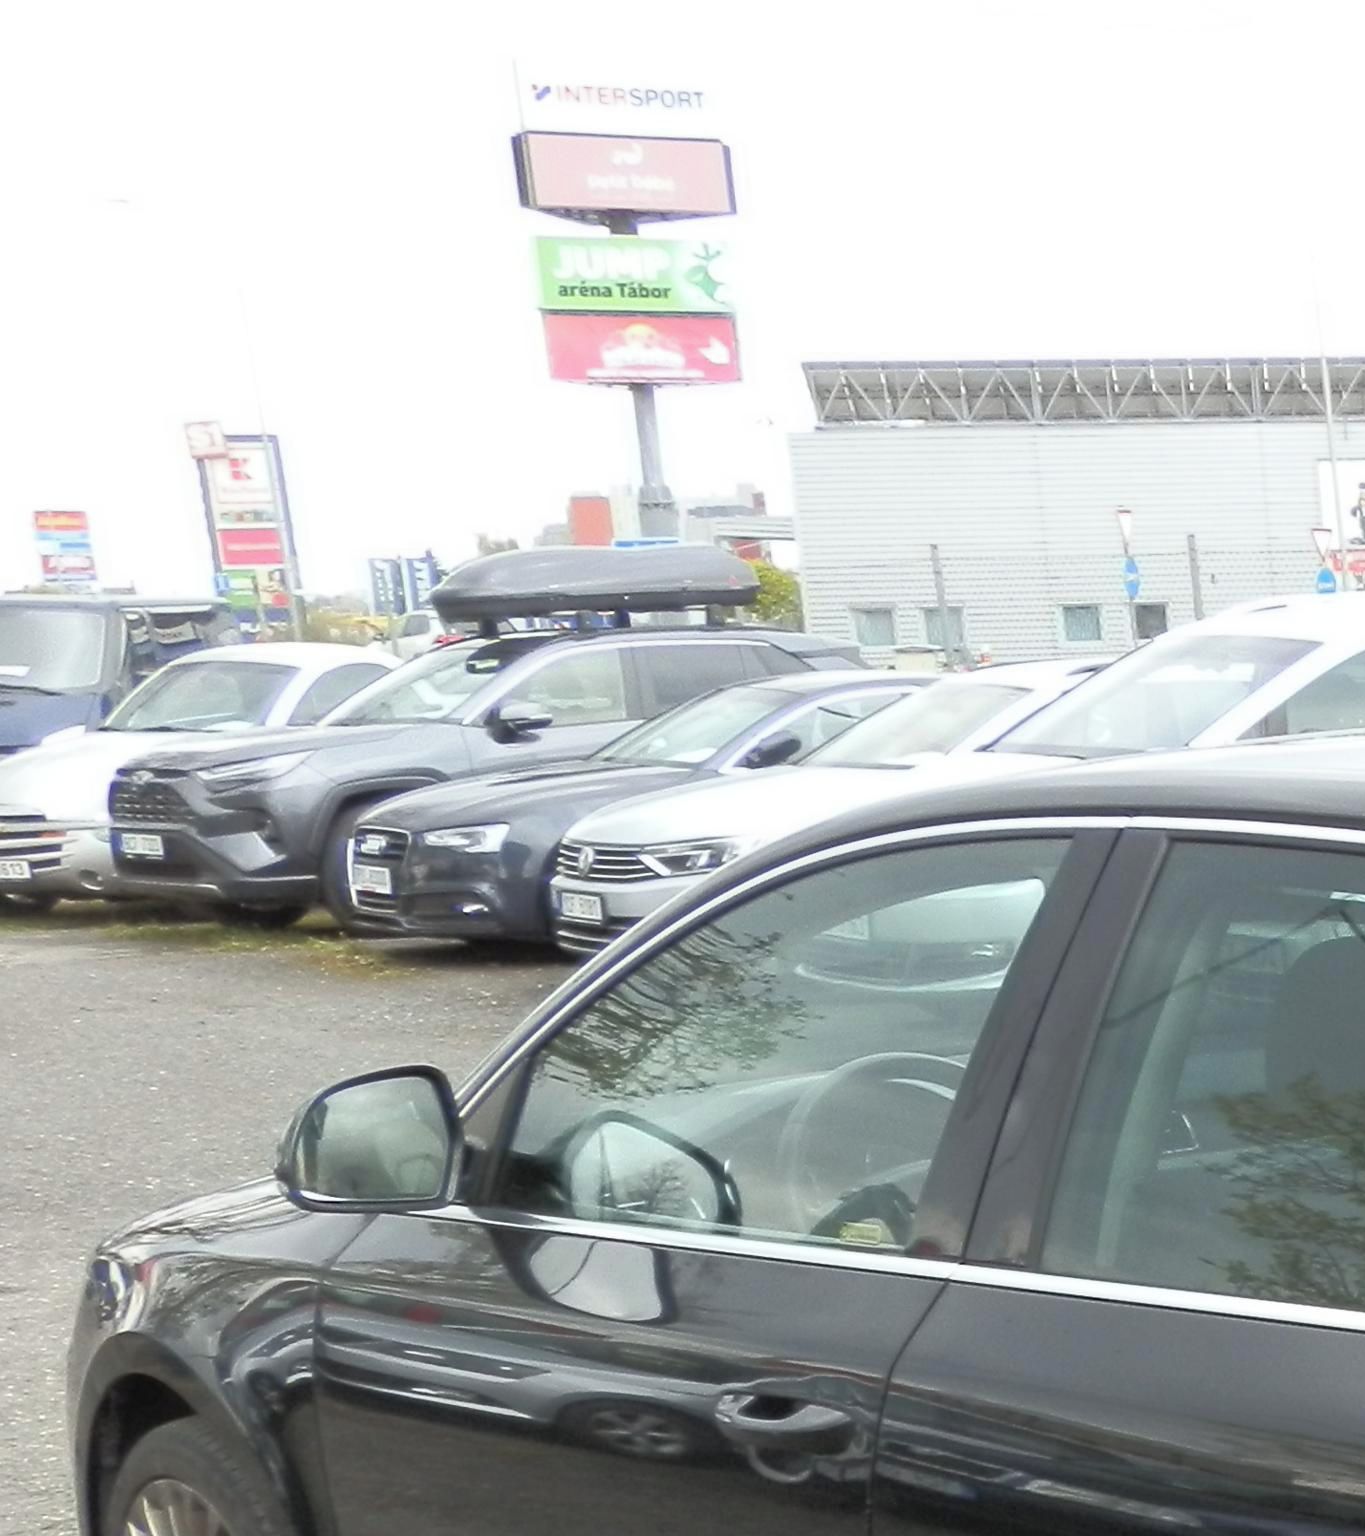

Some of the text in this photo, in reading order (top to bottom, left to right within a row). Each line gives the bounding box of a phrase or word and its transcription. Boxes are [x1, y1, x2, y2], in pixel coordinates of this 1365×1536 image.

[556, 84, 704, 109] INTERSPORT
[553, 245, 670, 280] JUMP
[557, 281, 673, 300] aréna Tábor
